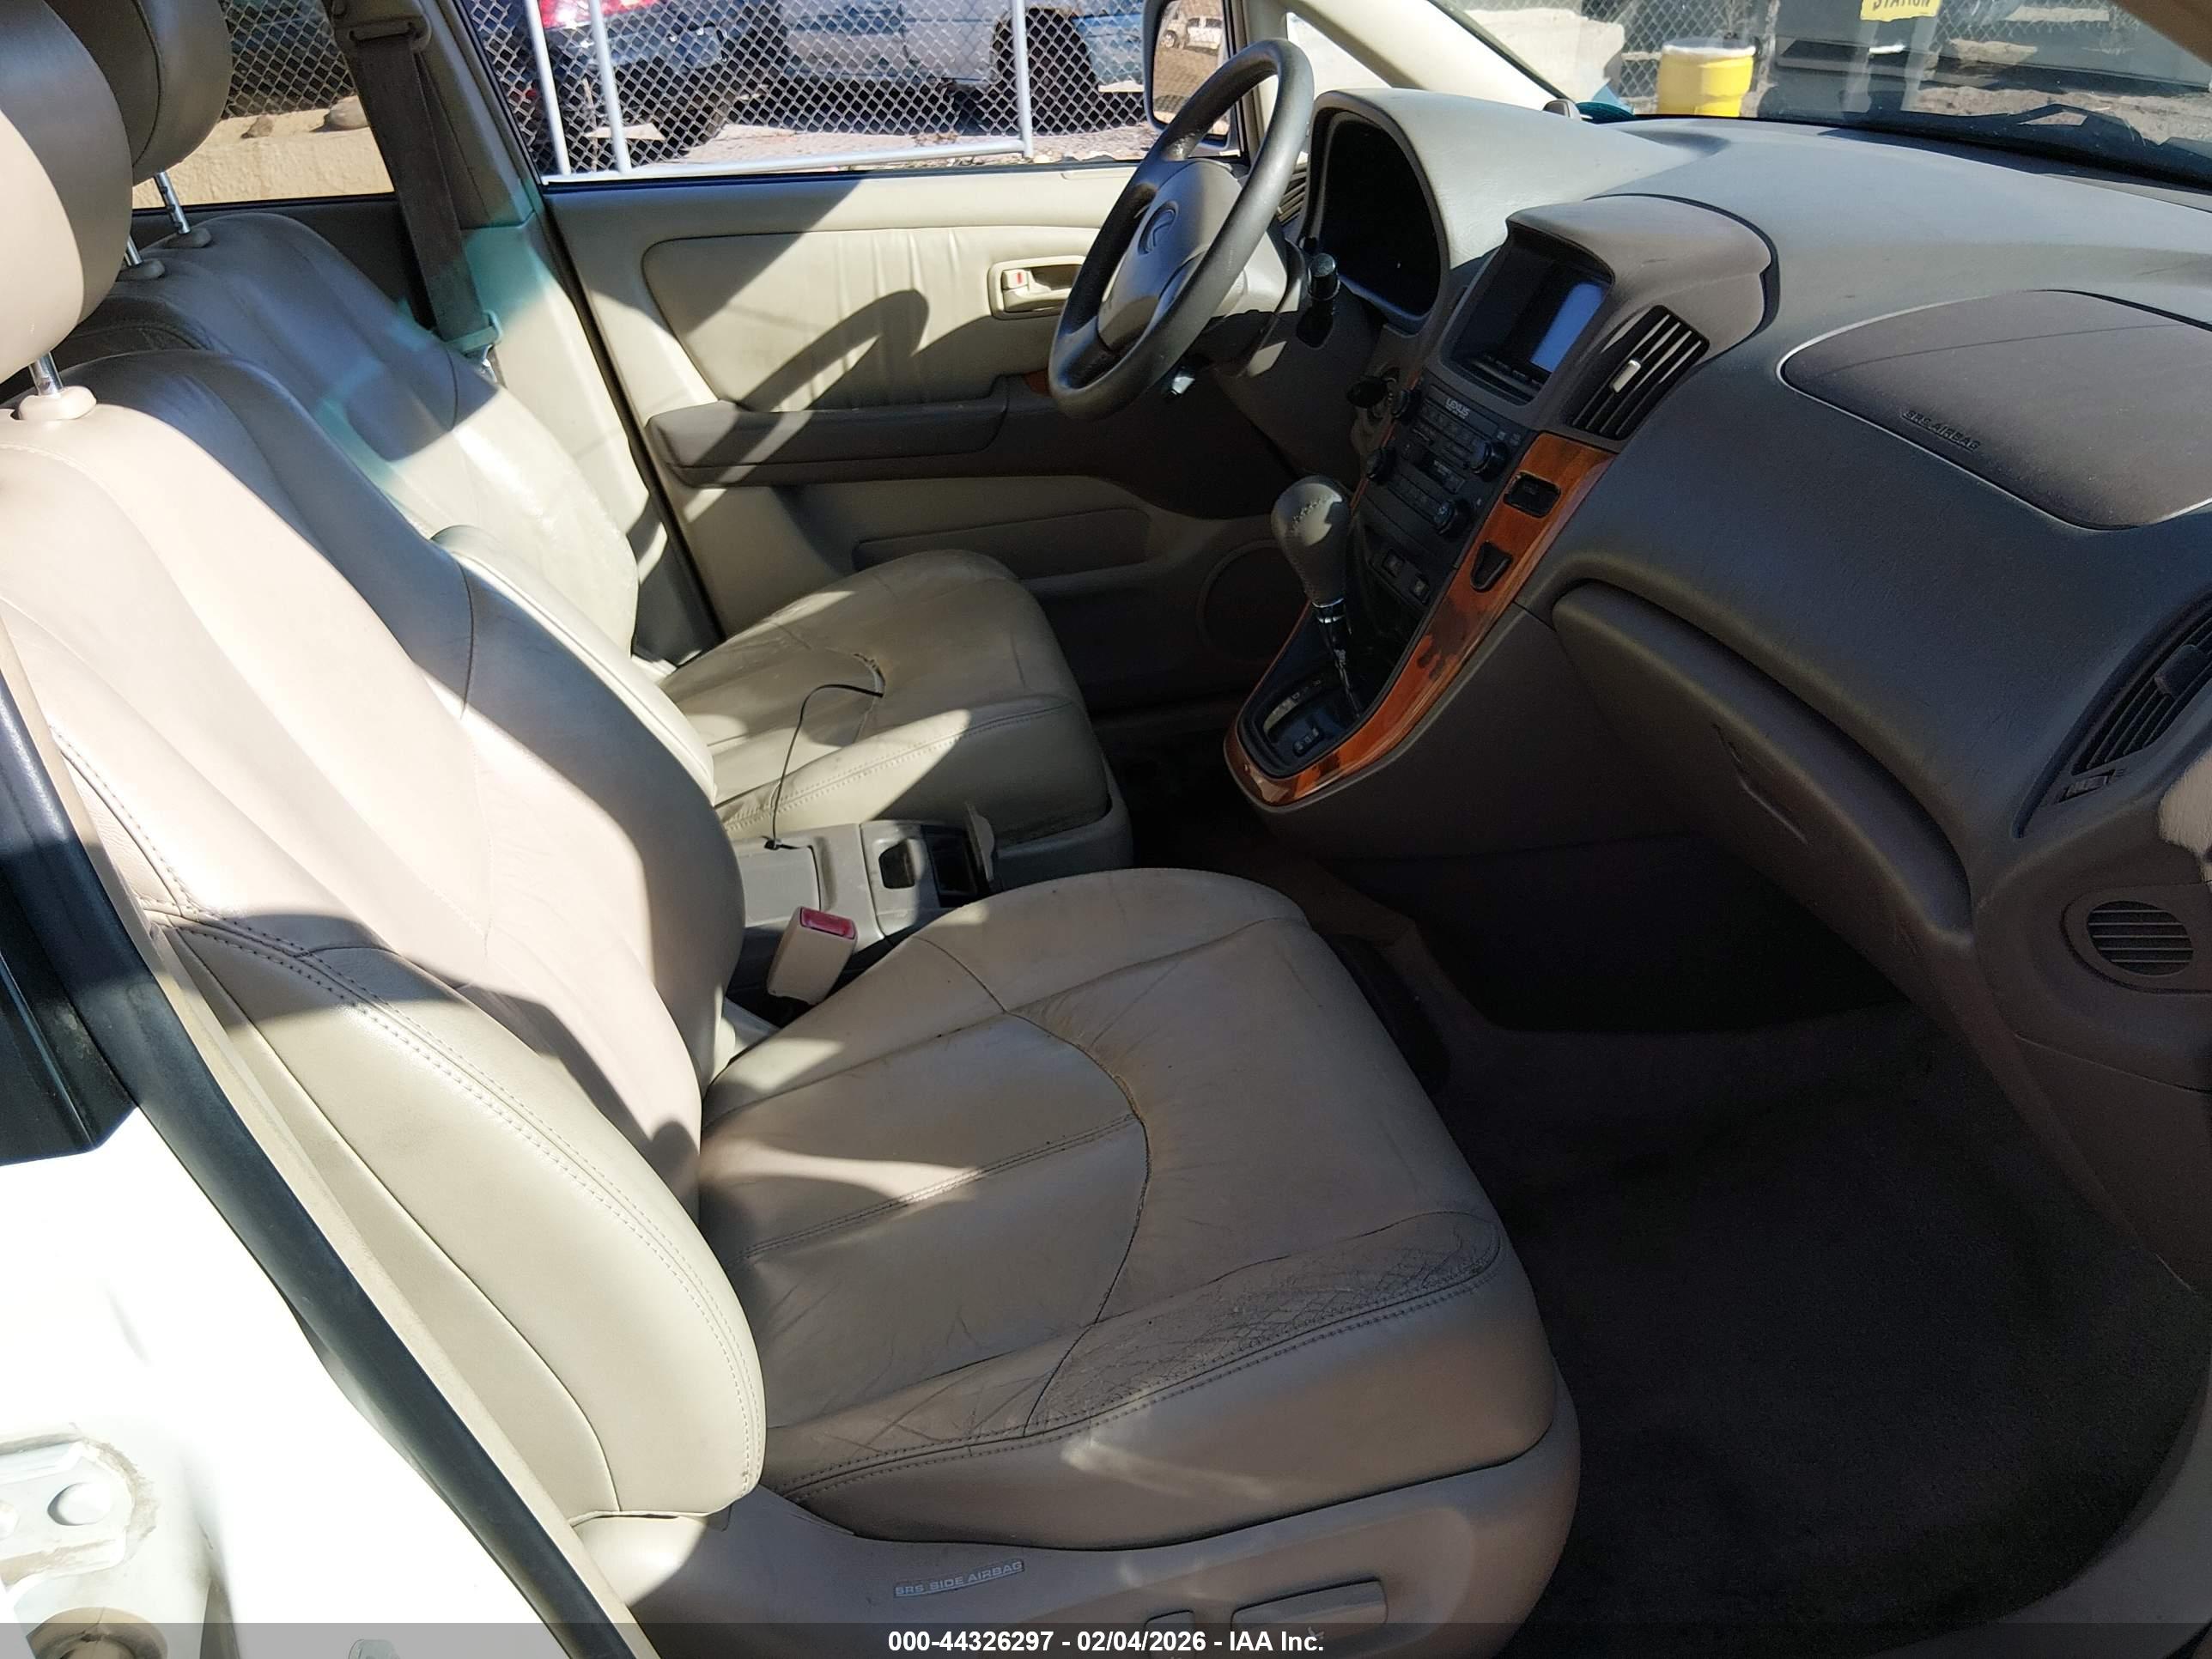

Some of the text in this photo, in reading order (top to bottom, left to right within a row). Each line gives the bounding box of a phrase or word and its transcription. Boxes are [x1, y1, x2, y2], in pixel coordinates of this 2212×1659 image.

[1445, 398, 1471, 417] LEXUS
[1902, 410, 1981, 447] SRS AIRBAG
[896, 1560, 1023, 1595] SRS SIDE AIRBAG
